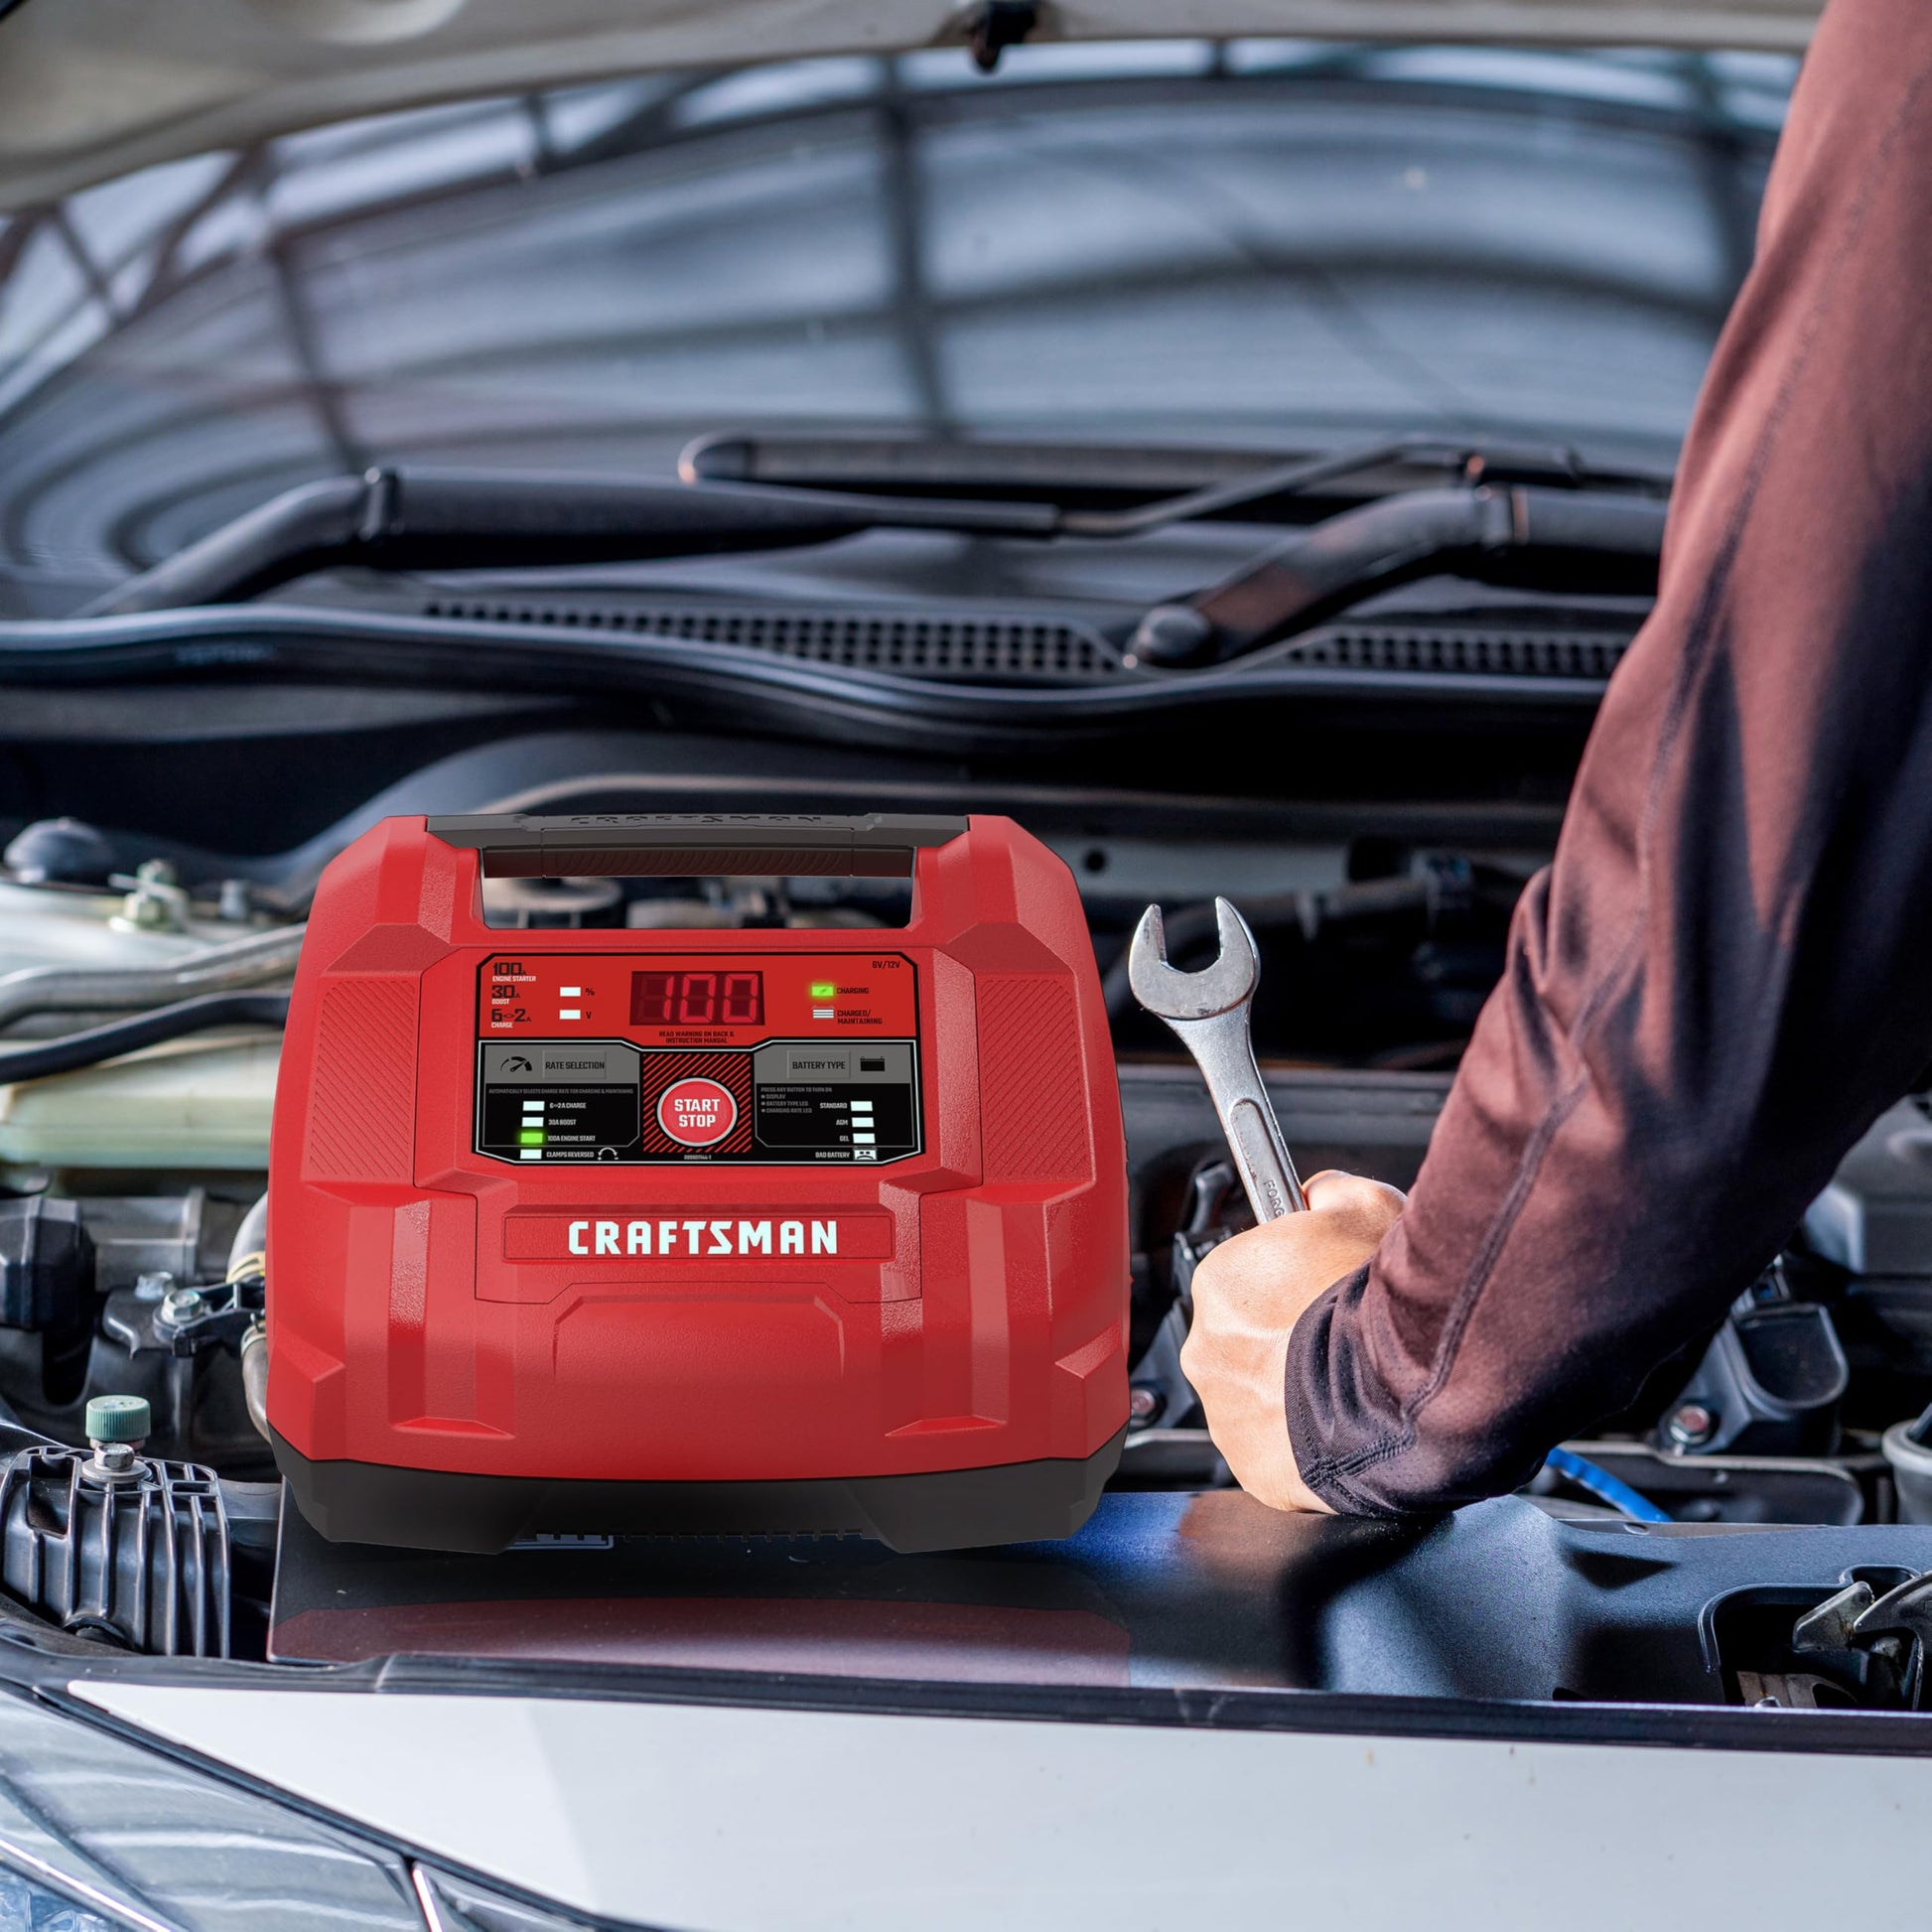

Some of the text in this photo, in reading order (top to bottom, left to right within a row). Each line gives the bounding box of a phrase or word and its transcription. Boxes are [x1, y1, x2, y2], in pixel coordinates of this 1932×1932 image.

[872, 960, 900, 969] 6V/12V
[663, 973, 759, 1024] 100
[586, 1011, 592, 1020] V
[545, 1061, 605, 1070] RATE SELECTION
[792, 1061, 846, 1070] BATTERY TYPE
[674, 1098, 720, 1112] START
[678, 1114, 717, 1128] STOP
[568, 1220, 838, 1255] CRAFTSMAN
